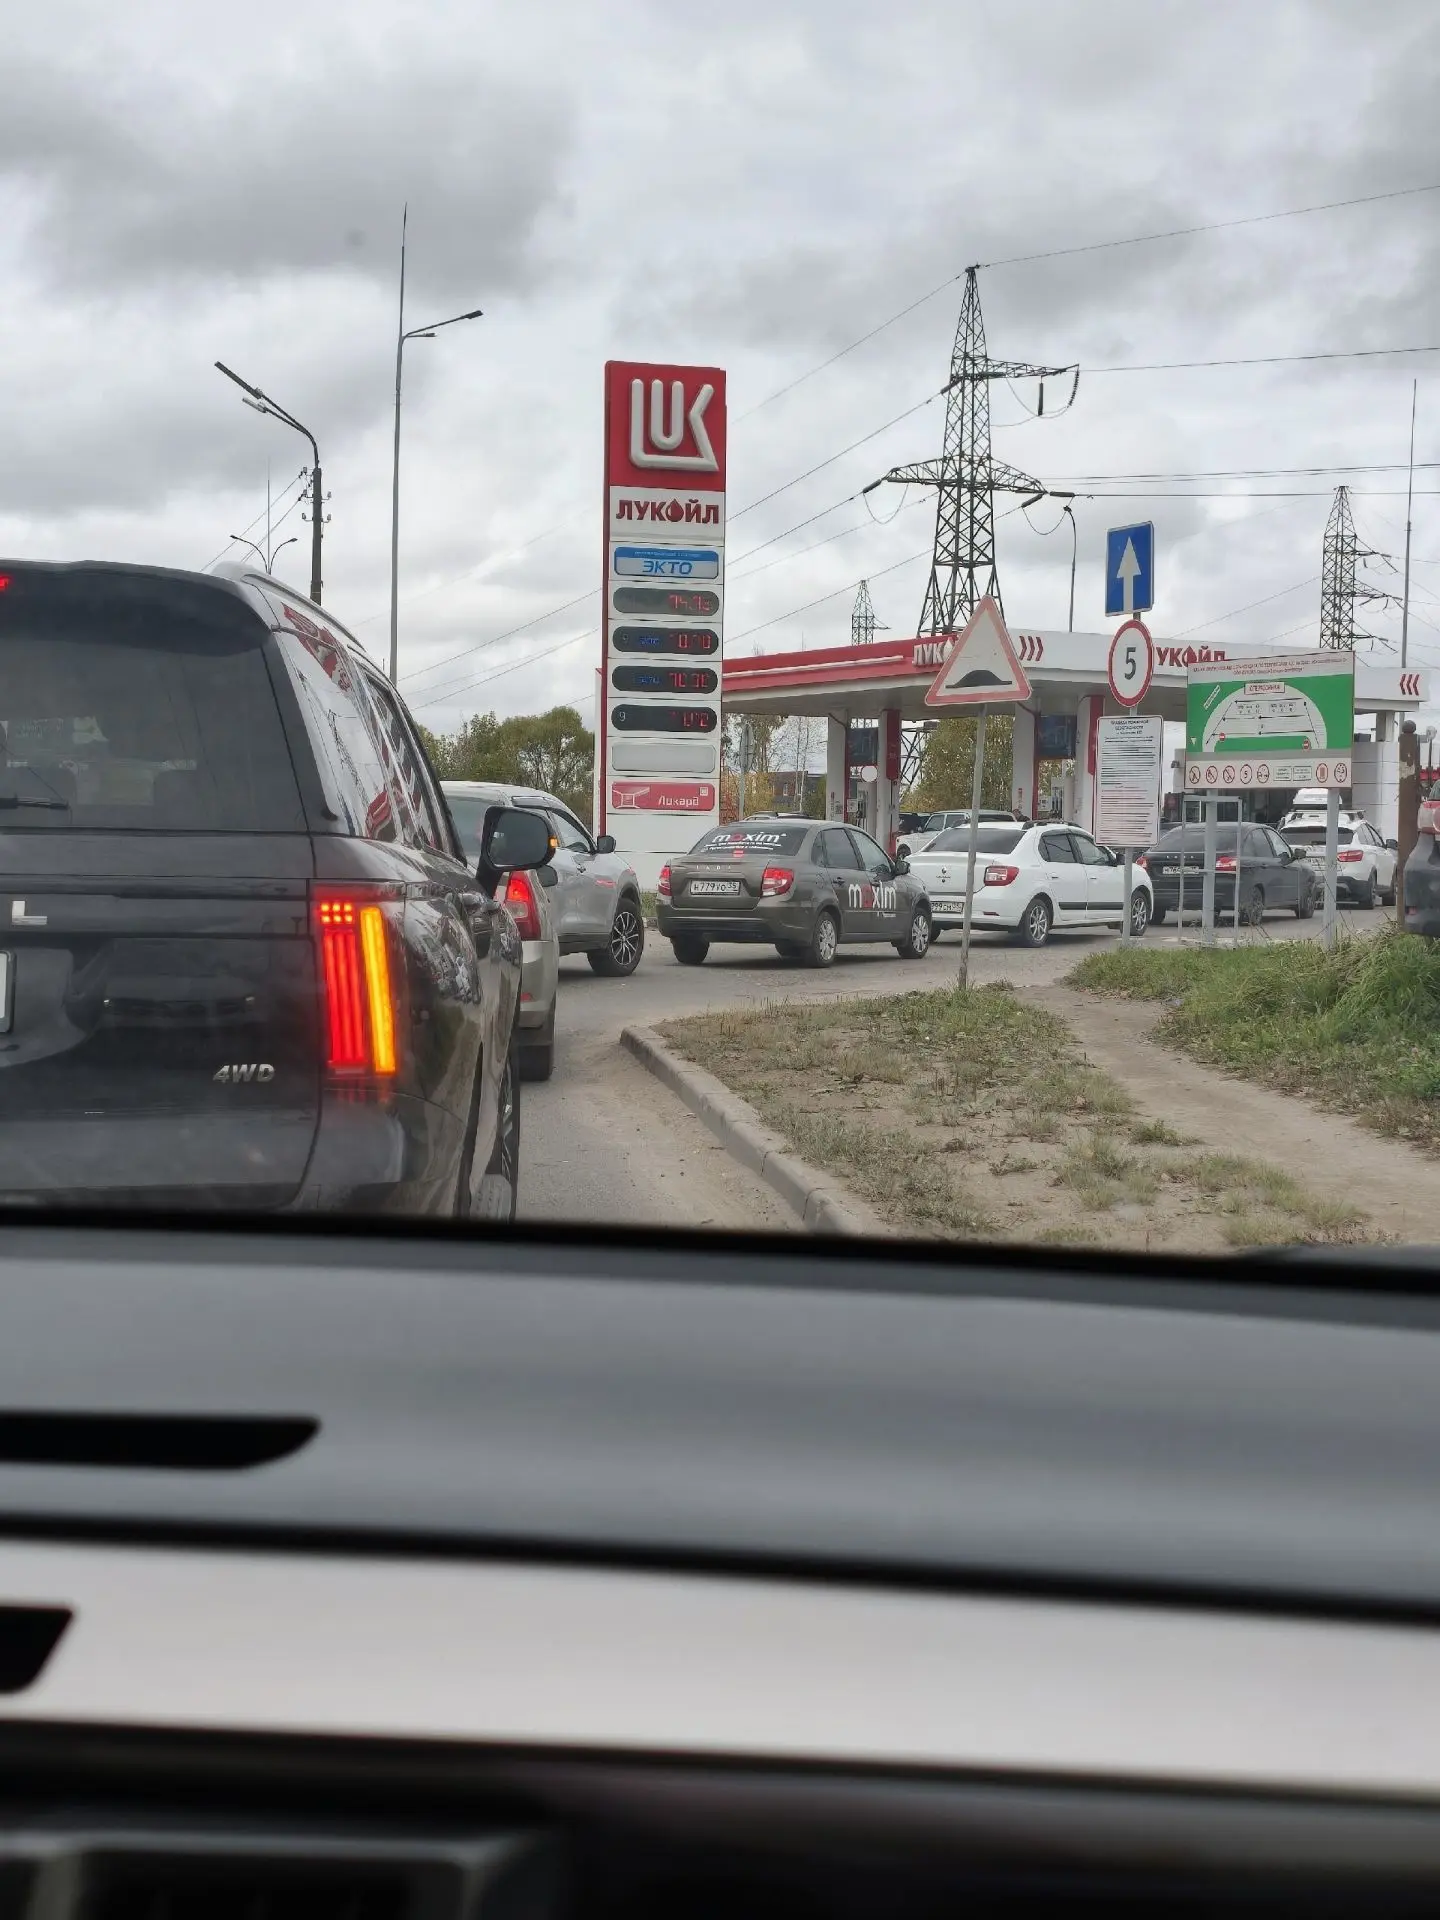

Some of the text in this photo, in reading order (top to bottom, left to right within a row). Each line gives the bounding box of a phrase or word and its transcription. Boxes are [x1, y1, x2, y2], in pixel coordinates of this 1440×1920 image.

[616, 499, 719, 524] ЛУКОЙЛ
[642, 560, 693, 575] ЭКТО
[1124, 647, 1137, 680] 5
[213, 1063, 275, 1083] 4WD
